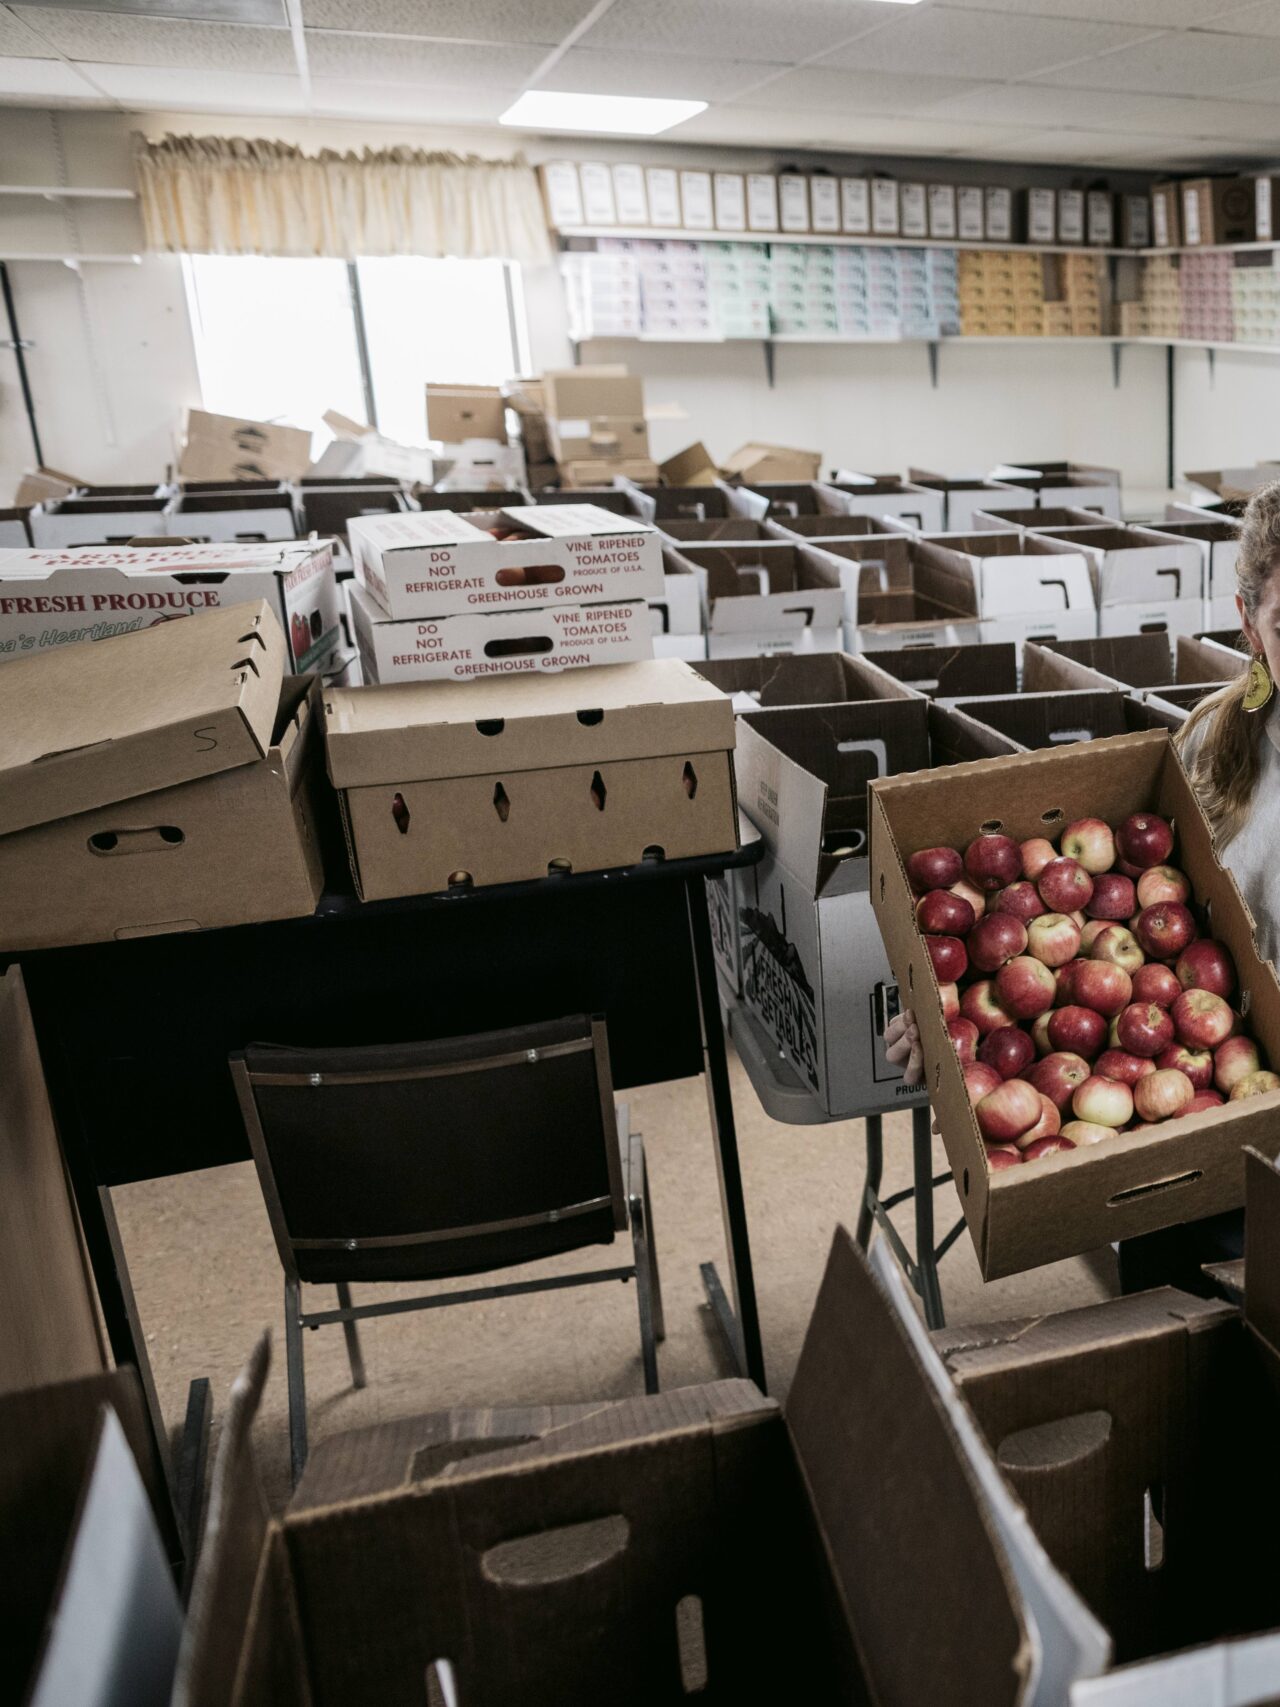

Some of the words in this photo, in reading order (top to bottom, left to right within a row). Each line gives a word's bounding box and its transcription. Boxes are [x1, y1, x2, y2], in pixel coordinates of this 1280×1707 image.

[565, 540, 593, 552] VINE
[599, 537, 645, 549] RIPENED
[430, 552, 450, 562] DO
[576, 551, 640, 565] TOMATOES
[428, 565, 456, 577] NOT
[573, 566, 607, 577] PRODUCE
[610, 566, 621, 574] OF
[624, 564, 645, 573] U.S.A.
[405, 577, 485, 594] REFRIGERATE
[468, 588, 549, 605] GREENHOUSE
[555, 583, 604, 597] GROWN
[1, 594, 88, 616] FRESH
[93, 591, 221, 611] PRODUCE
[553, 612, 580, 624] VINE
[586, 609, 633, 622] RIPENED
[40, 616, 143, 646] Heartland
[418, 624, 438, 635] DO
[563, 622, 627, 637] TOMATOES
[416, 638, 443, 650] NOT
[560, 637, 594, 648] PRODUCE
[598, 637, 608, 645] OF
[611, 634, 632, 644] U.S.A.
[393, 649, 472, 666] REFRIGERATE
[454, 660, 536, 676] GREENHOUSE
[542, 654, 590, 668] GROWN
